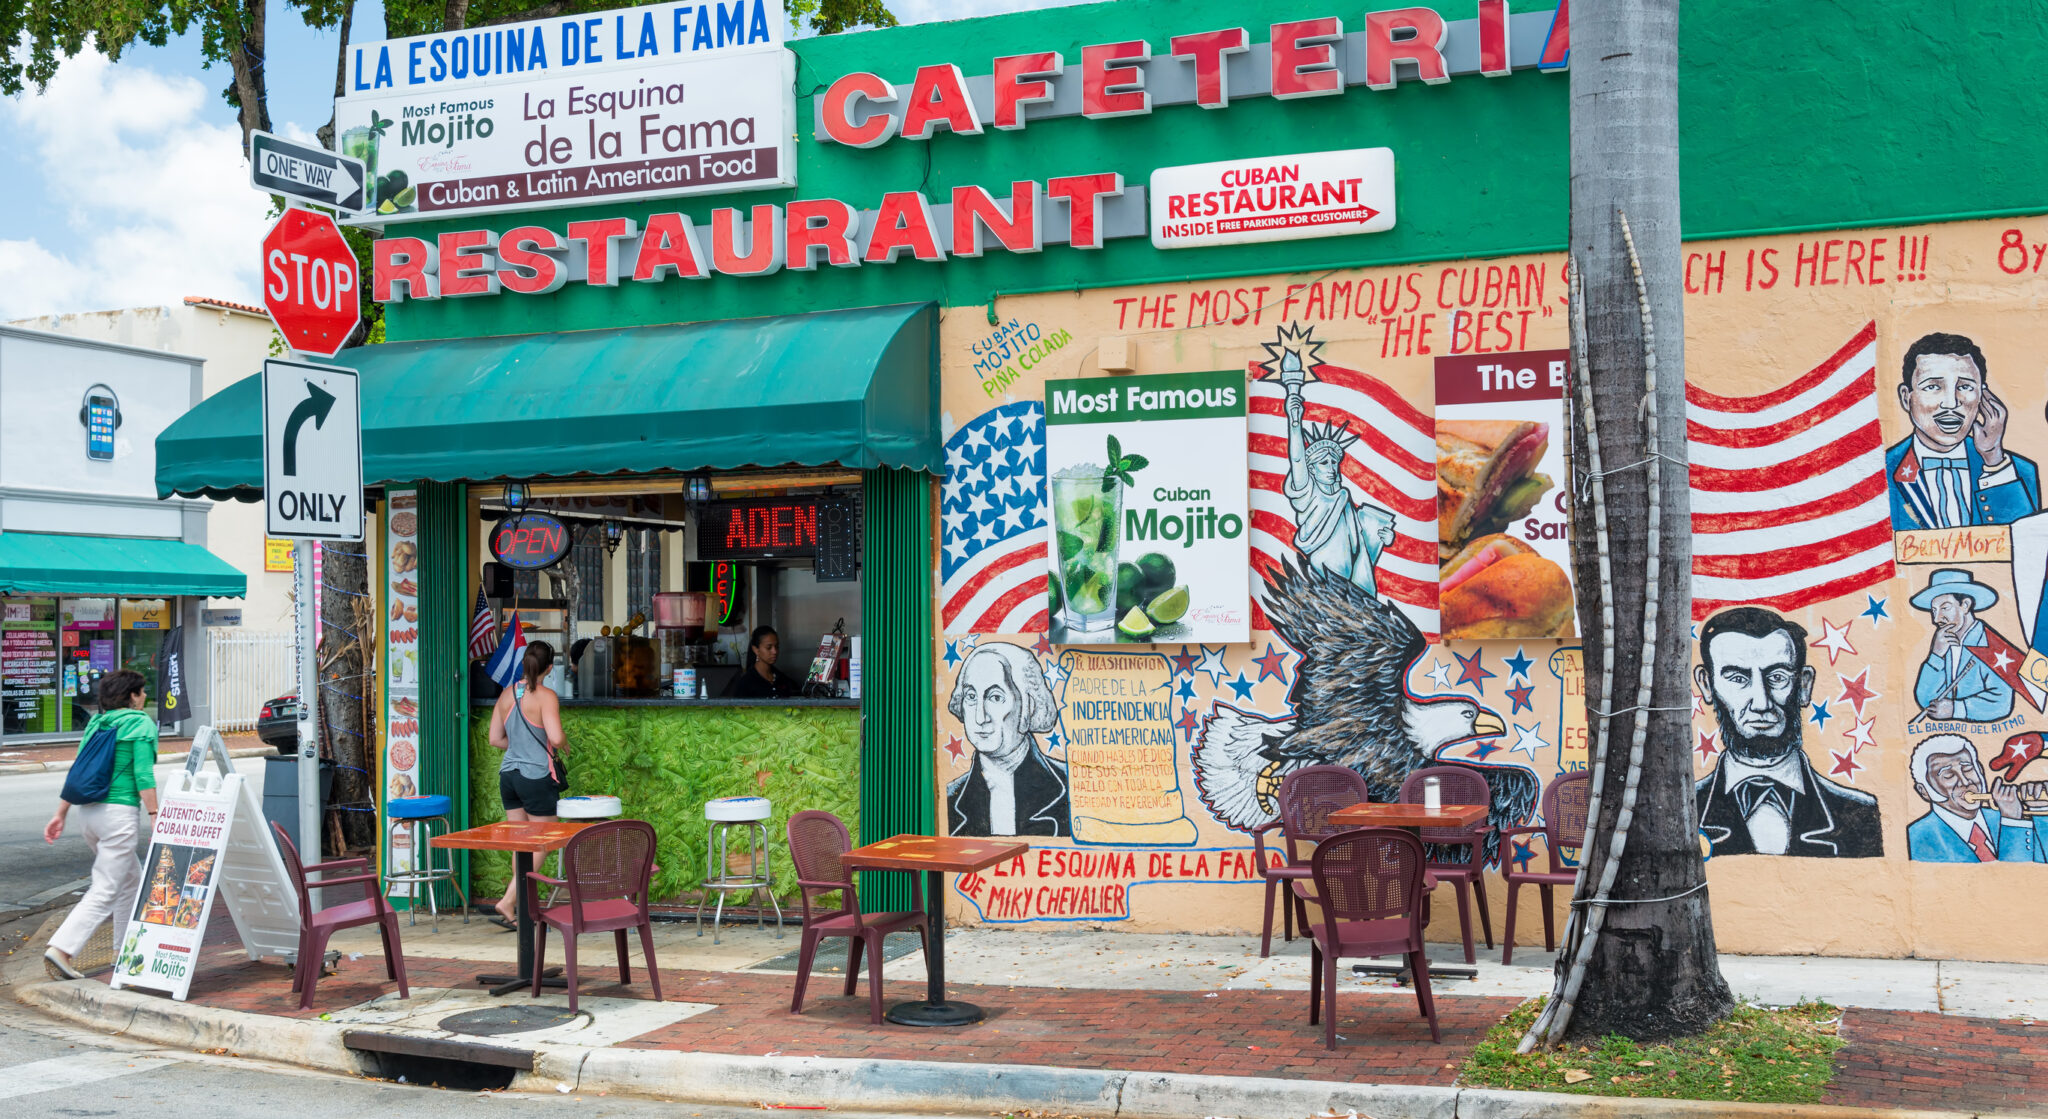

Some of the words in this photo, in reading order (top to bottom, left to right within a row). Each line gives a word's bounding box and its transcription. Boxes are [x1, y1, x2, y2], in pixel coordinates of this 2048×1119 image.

[355, 46, 393, 91] LA
[409, 26, 548, 85] ESQUINA
[561, 18, 603, 66] DE
[616, 12, 659, 60] LA
[674, 0, 770, 53] FAMA
[822, 0, 1570, 149] CAFETERI
[402, 103, 435, 119] Most
[440, 99, 494, 115] Famous
[524, 92, 555, 121] La
[568, 78, 684, 120] Esquina
[402, 114, 494, 149] Mojito
[524, 124, 573, 168] de
[589, 118, 622, 160] la
[640, 113, 755, 155] Fama
[267, 153, 298, 180] ONE
[304, 163, 333, 189] WAY
[429, 180, 499, 206] Cuban
[506, 180, 519, 198] &
[526, 170, 577, 196] Latin
[585, 161, 691, 190] American
[700, 149, 757, 179] Food
[1221, 164, 1299, 188] CUBAN
[1168, 178, 1363, 219] RESTAURANT
[373, 172, 1124, 303] RESTAURANT
[1162, 222, 1214, 239] INSIDE
[1220, 221, 1241, 231] FREE
[1243, 217, 1287, 229] PARKING
[1289, 214, 1308, 226] FOR
[1310, 209, 1369, 223] CUSTOMERS
[269, 249, 353, 312] STOP
[1114, 294, 1178, 330] THE
[1187, 286, 1270, 326] MOST
[1282, 272, 1423, 323] FAMOUS
[1437, 262, 1546, 310] CUBAN
[1746, 248, 1780, 292] IS
[972, 318, 1020, 355] CUBAN
[973, 323, 1041, 379] MOJITO
[1018, 328, 1073, 370] COLADA
[1477, 363, 1537, 391] The
[1053, 387, 1118, 415] Most
[1127, 386, 1237, 411] Famous
[278, 489, 346, 523] ONLY
[1153, 487, 1211, 502] Cuban
[495, 526, 562, 555] OPEN
[827, 507, 843, 574] OPEN
[1125, 506, 1243, 548] Mojito
[1900, 532, 1952, 562] Beny
[170, 653, 181, 697] smart
[1072, 677, 1109, 695] PADRE
[1111, 678, 1127, 696] DE
[1131, 679, 1147, 697] LA
[1073, 701, 1170, 721] INDEPENDENCIA
[1908, 724, 1922, 735] EL
[1925, 722, 1967, 733] BARBARO
[1971, 724, 1989, 735] DEL
[1992, 714, 2025, 734] RITMO
[1072, 728, 1174, 746] NORTEAMERICANA
[156, 821, 189, 836] CUBAN
[191, 824, 222, 839] BUFFET
[160, 807, 203, 822] AUTENTIC
[203, 811, 226, 823] $12.95
[994, 852, 1026, 878] LA
[1038, 850, 1136, 879] ESQUINA
[1149, 852, 1172, 878] DE
[1180, 854, 1209, 878] LA
[959, 871, 987, 900] DE
[986, 886, 1032, 919] MIKY
[1036, 884, 1126, 916] CHEVALIER
[151, 958, 186, 979] Mojito
